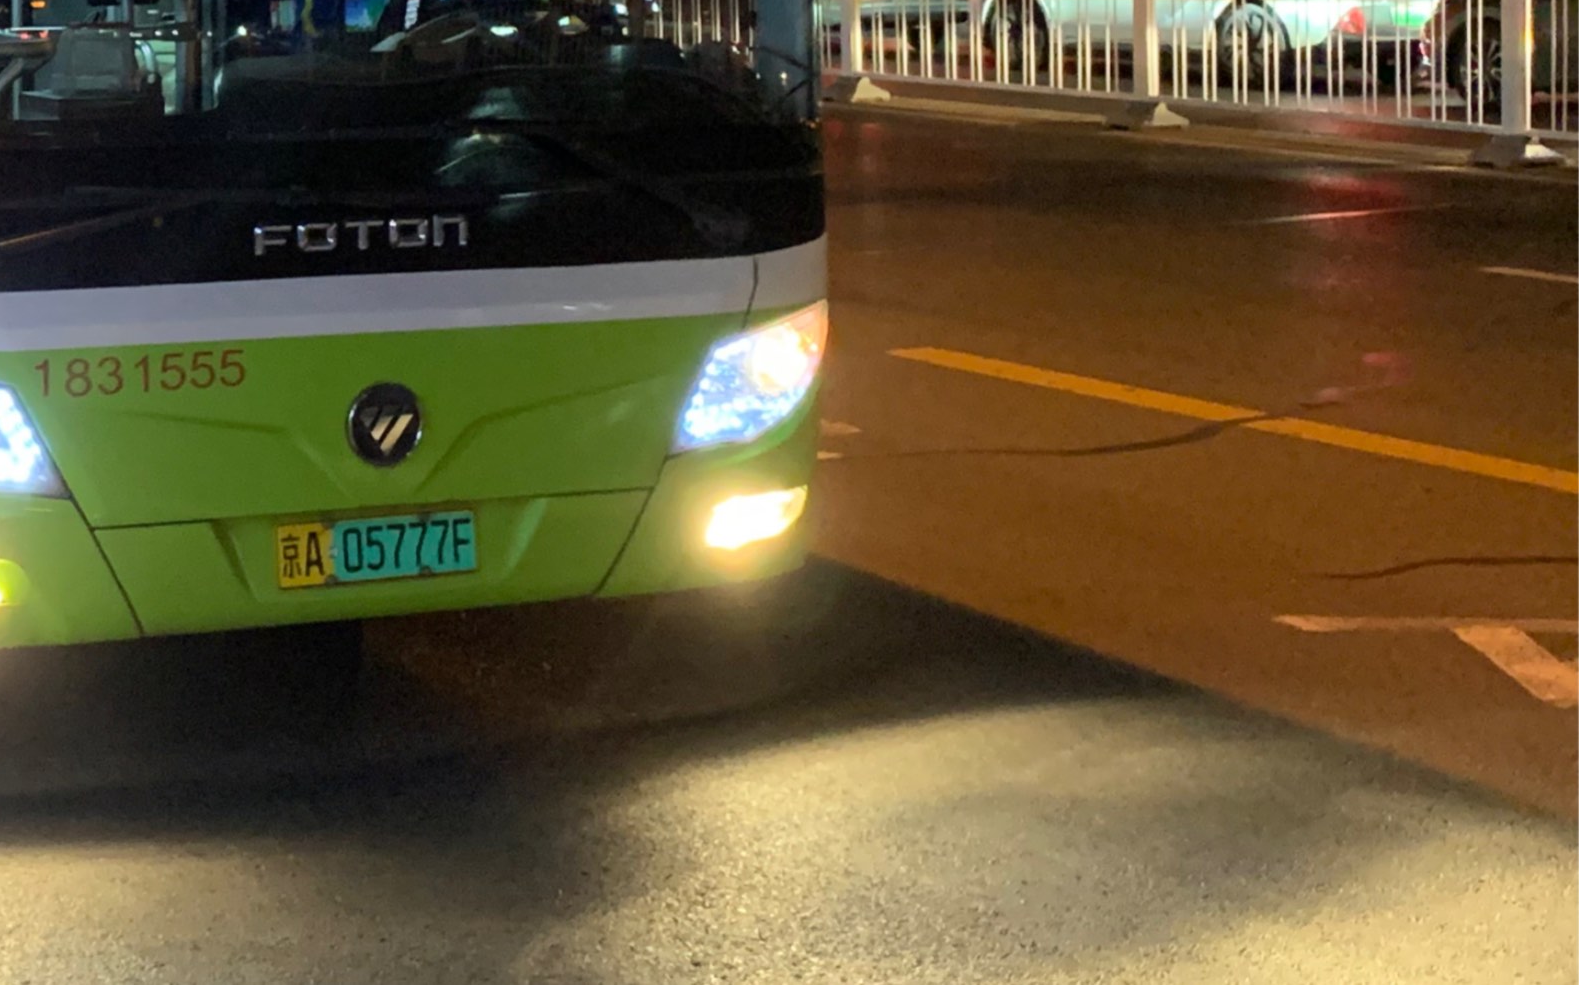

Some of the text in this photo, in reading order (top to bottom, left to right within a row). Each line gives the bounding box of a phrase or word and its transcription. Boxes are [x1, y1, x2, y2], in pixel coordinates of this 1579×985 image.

[253, 214, 469, 256] FOTON
[34, 348, 247, 398] 1831555
[280, 517, 472, 581] 京A 05777F
